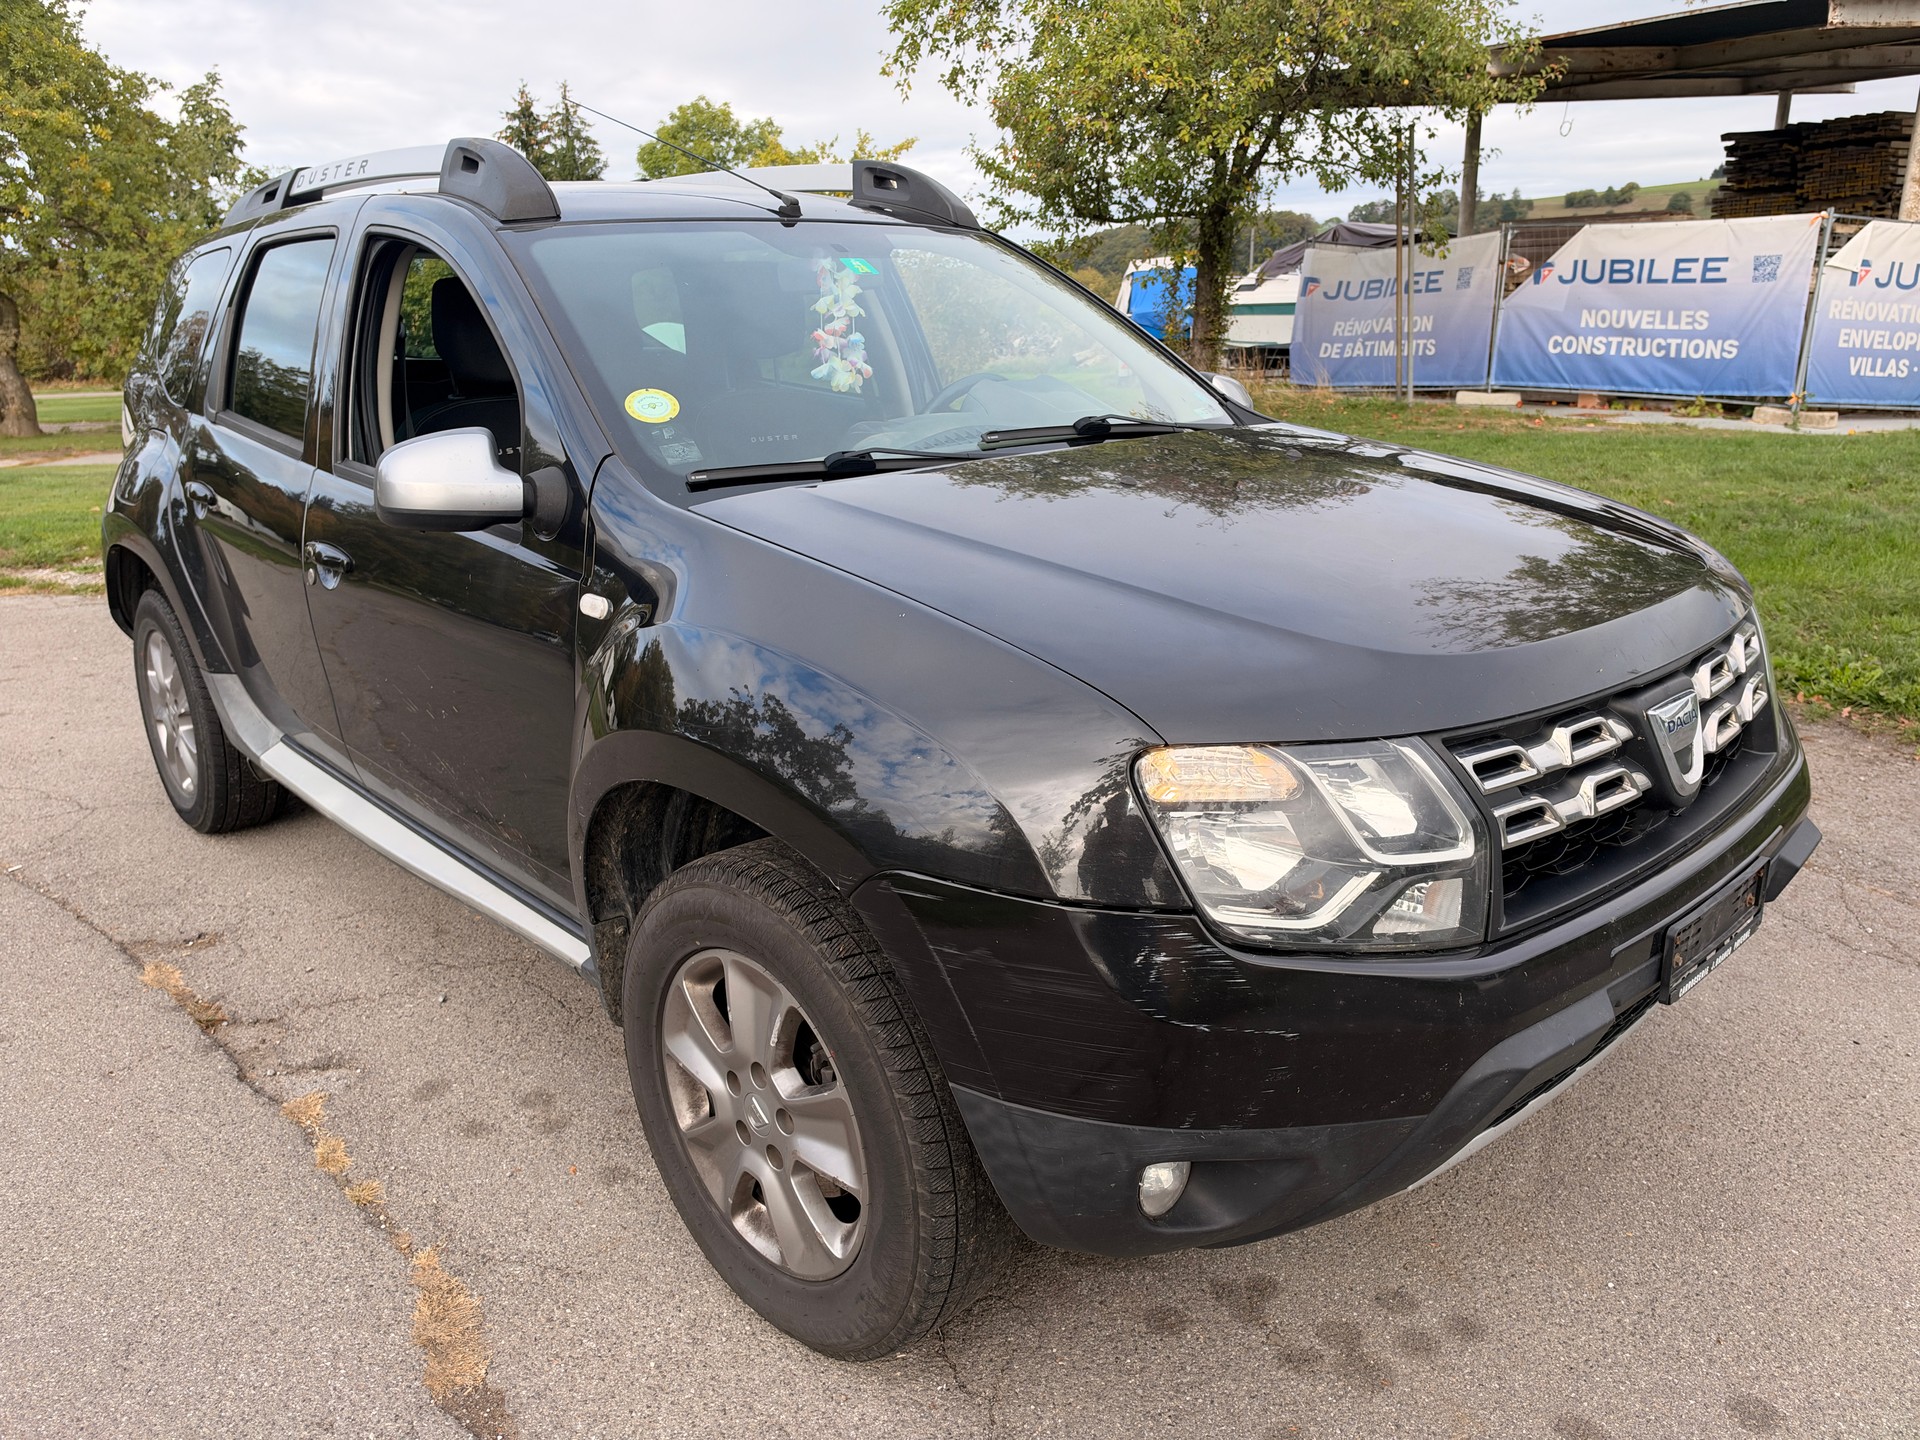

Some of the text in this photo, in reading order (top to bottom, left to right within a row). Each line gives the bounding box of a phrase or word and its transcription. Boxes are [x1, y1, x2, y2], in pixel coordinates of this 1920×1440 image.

[296, 159, 369, 189] DUSTER
[1557, 256, 1730, 285] JUBILEE
[1322, 270, 1445, 301] JUBILEE
[1580, 308, 1710, 330] NOUVELLES
[1318, 342, 1344, 359] DE
[1547, 335, 1740, 360] CONSTRUCTIONS
[1849, 356, 1910, 378] VILLAS
[750, 434, 799, 443] DUSTER
[1667, 709, 1698, 733] DACIA
